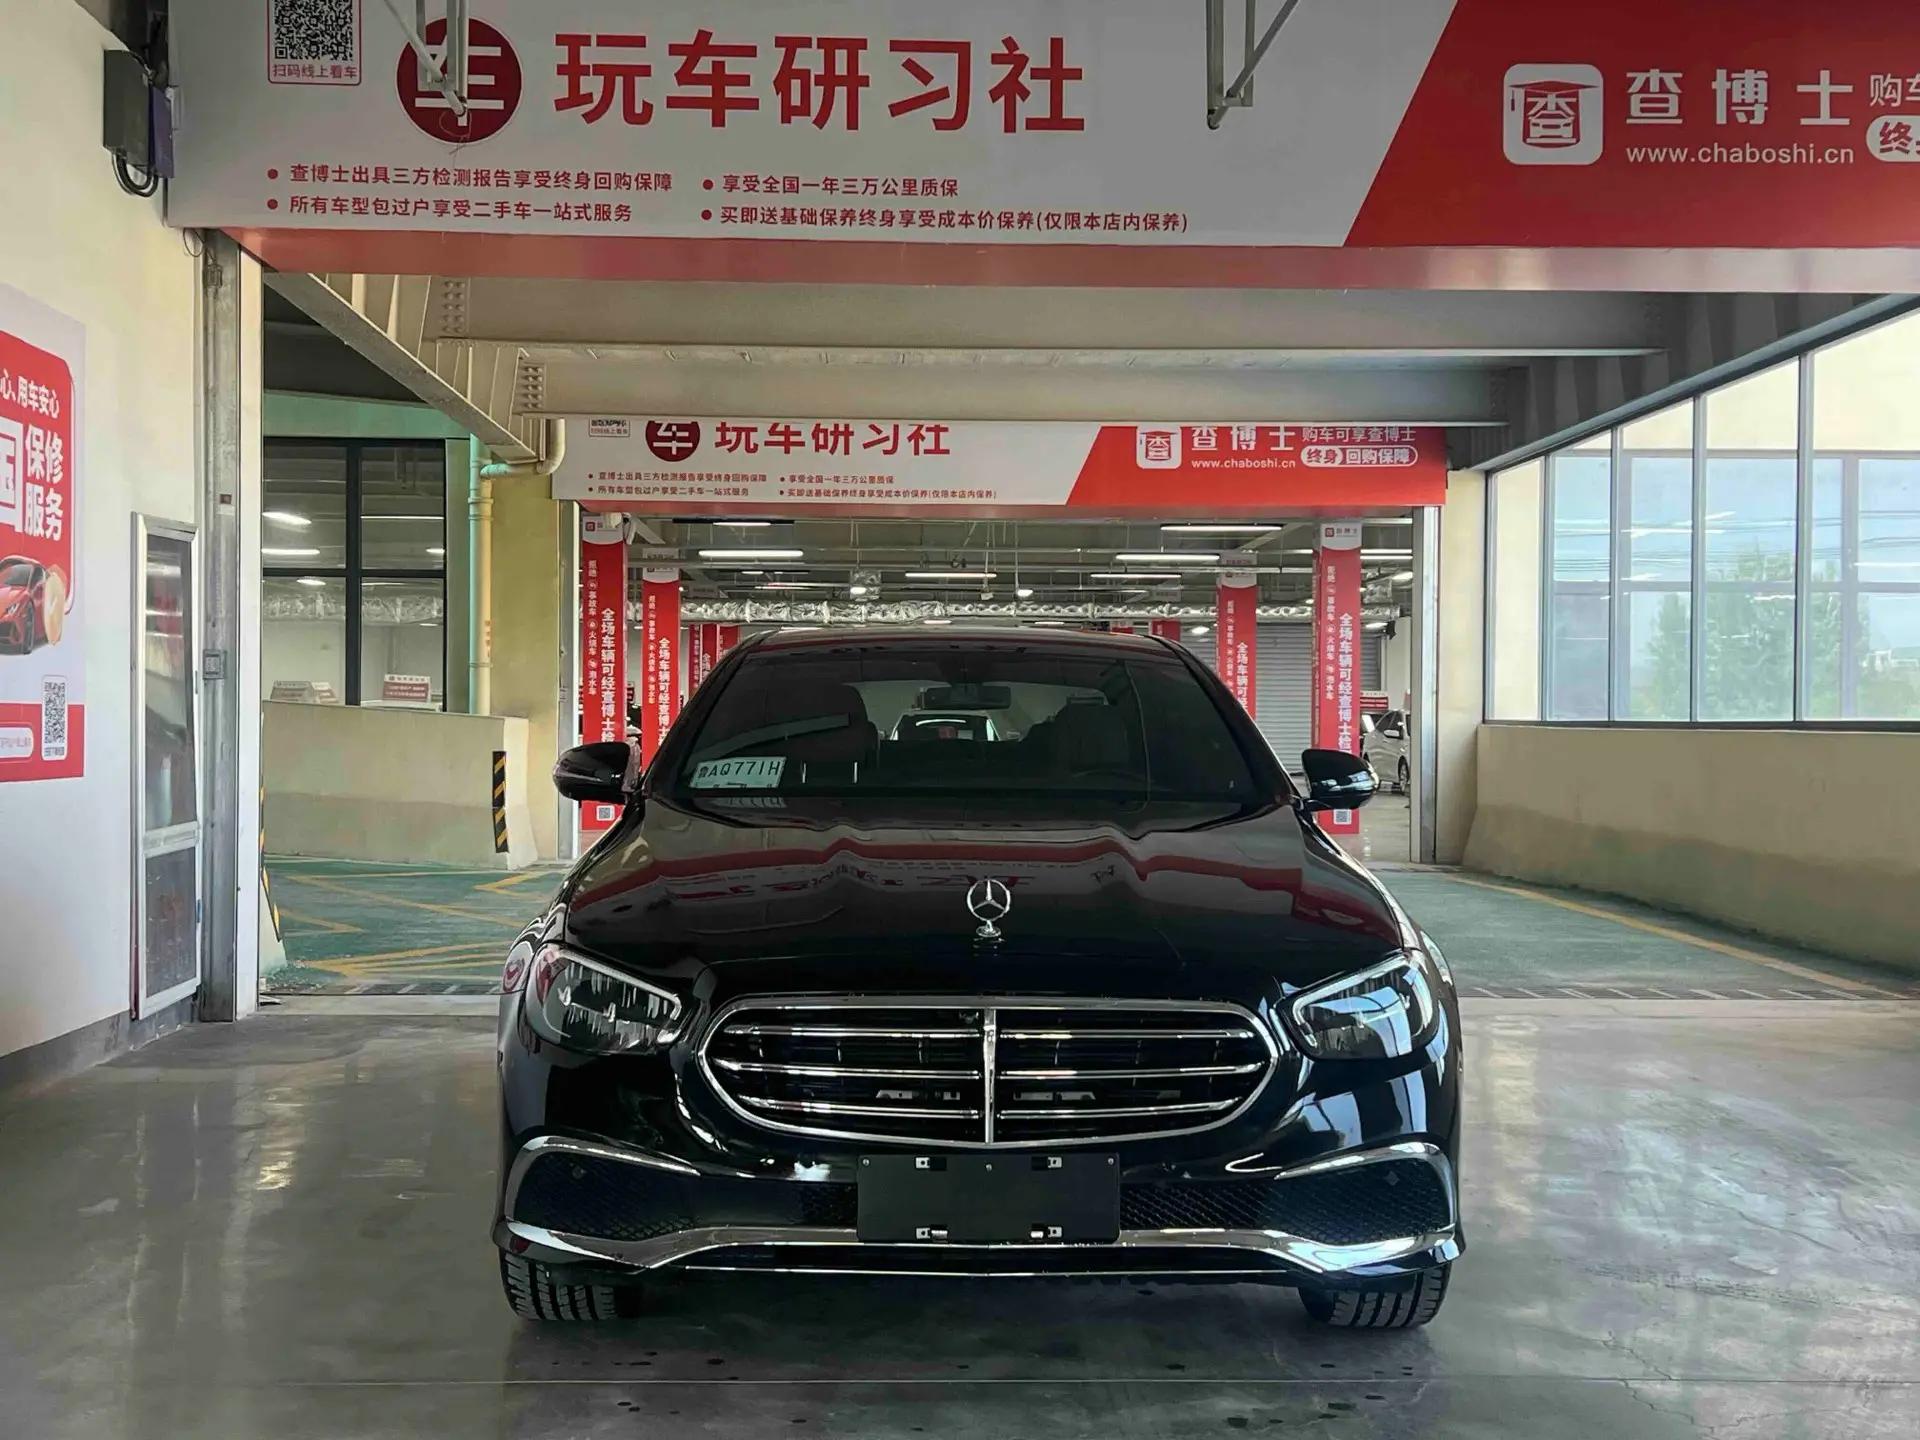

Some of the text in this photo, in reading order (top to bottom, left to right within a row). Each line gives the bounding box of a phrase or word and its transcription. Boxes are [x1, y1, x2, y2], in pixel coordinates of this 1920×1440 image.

[273, 64, 358, 79] 扫码线上看车
[554, 29, 1086, 134] 玩车研习社
[1626, 69, 1854, 126] 查博士
[1879, 121, 1920, 155] 终
[1626, 141, 1854, 165] www.chaboshi.cn
[290, 164, 673, 193] 查博士出具三方检测报告享受终身回购保障
[722, 174, 959, 198] 享受全国一年三万公里质保
[290, 195, 632, 223] 所有车型包过户享受二手车一站式服务
[720, 206, 1188, 233] 买即送基础保养终身享受成本价保养(仅限本店内保养)
[1192, 426, 1296, 451] 查博士
[1302, 426, 1416, 443] 购车可享查博士
[26, 424, 63, 484] 保修
[1192, 457, 1296, 469] www.chaboshi.cn
[1307, 447, 1411, 465] 终身回购保障
[25, 483, 63, 541] 服务
